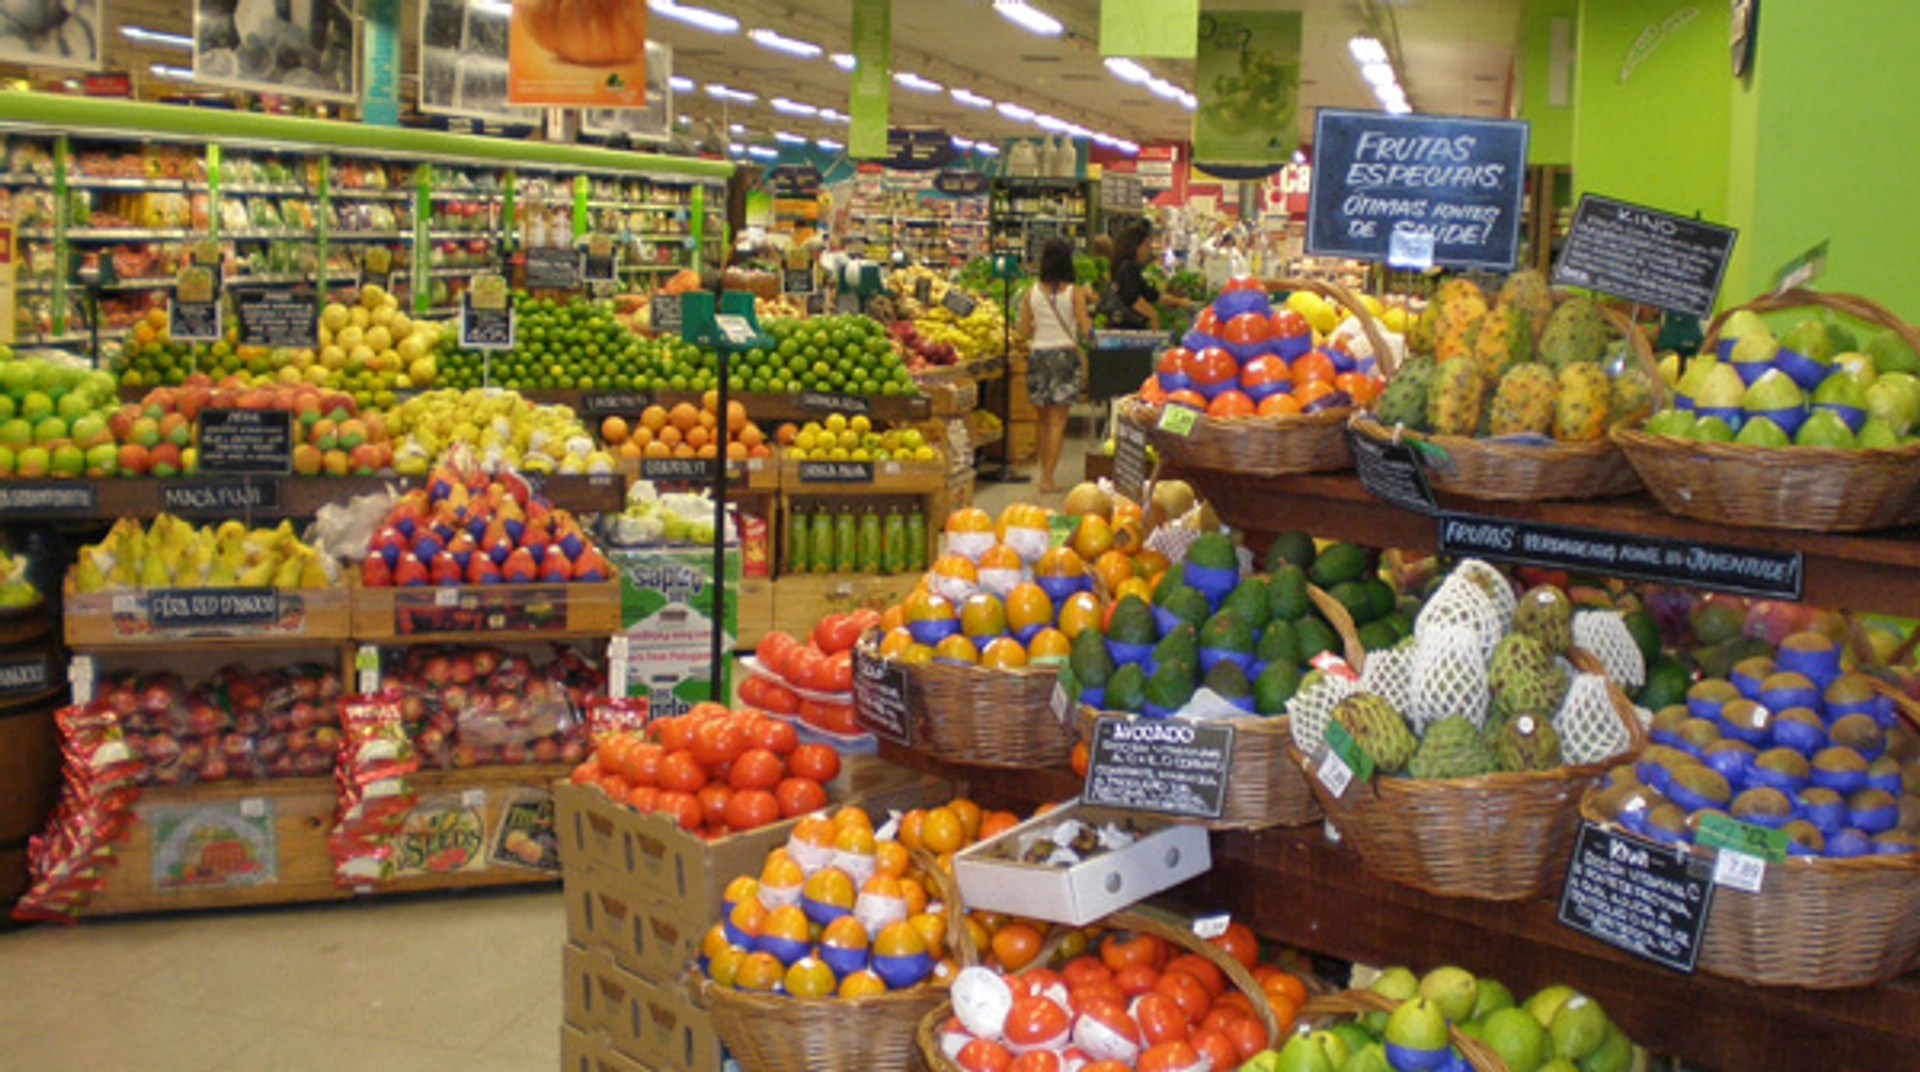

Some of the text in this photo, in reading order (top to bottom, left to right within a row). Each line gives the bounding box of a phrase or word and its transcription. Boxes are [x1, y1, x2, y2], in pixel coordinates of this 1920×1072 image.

[1356, 131, 1476, 161] FRUTAS
[1347, 220, 1378, 238] DE
[1619, 206, 1677, 235] KINO
[1445, 521, 1513, 550] FRUTAS
